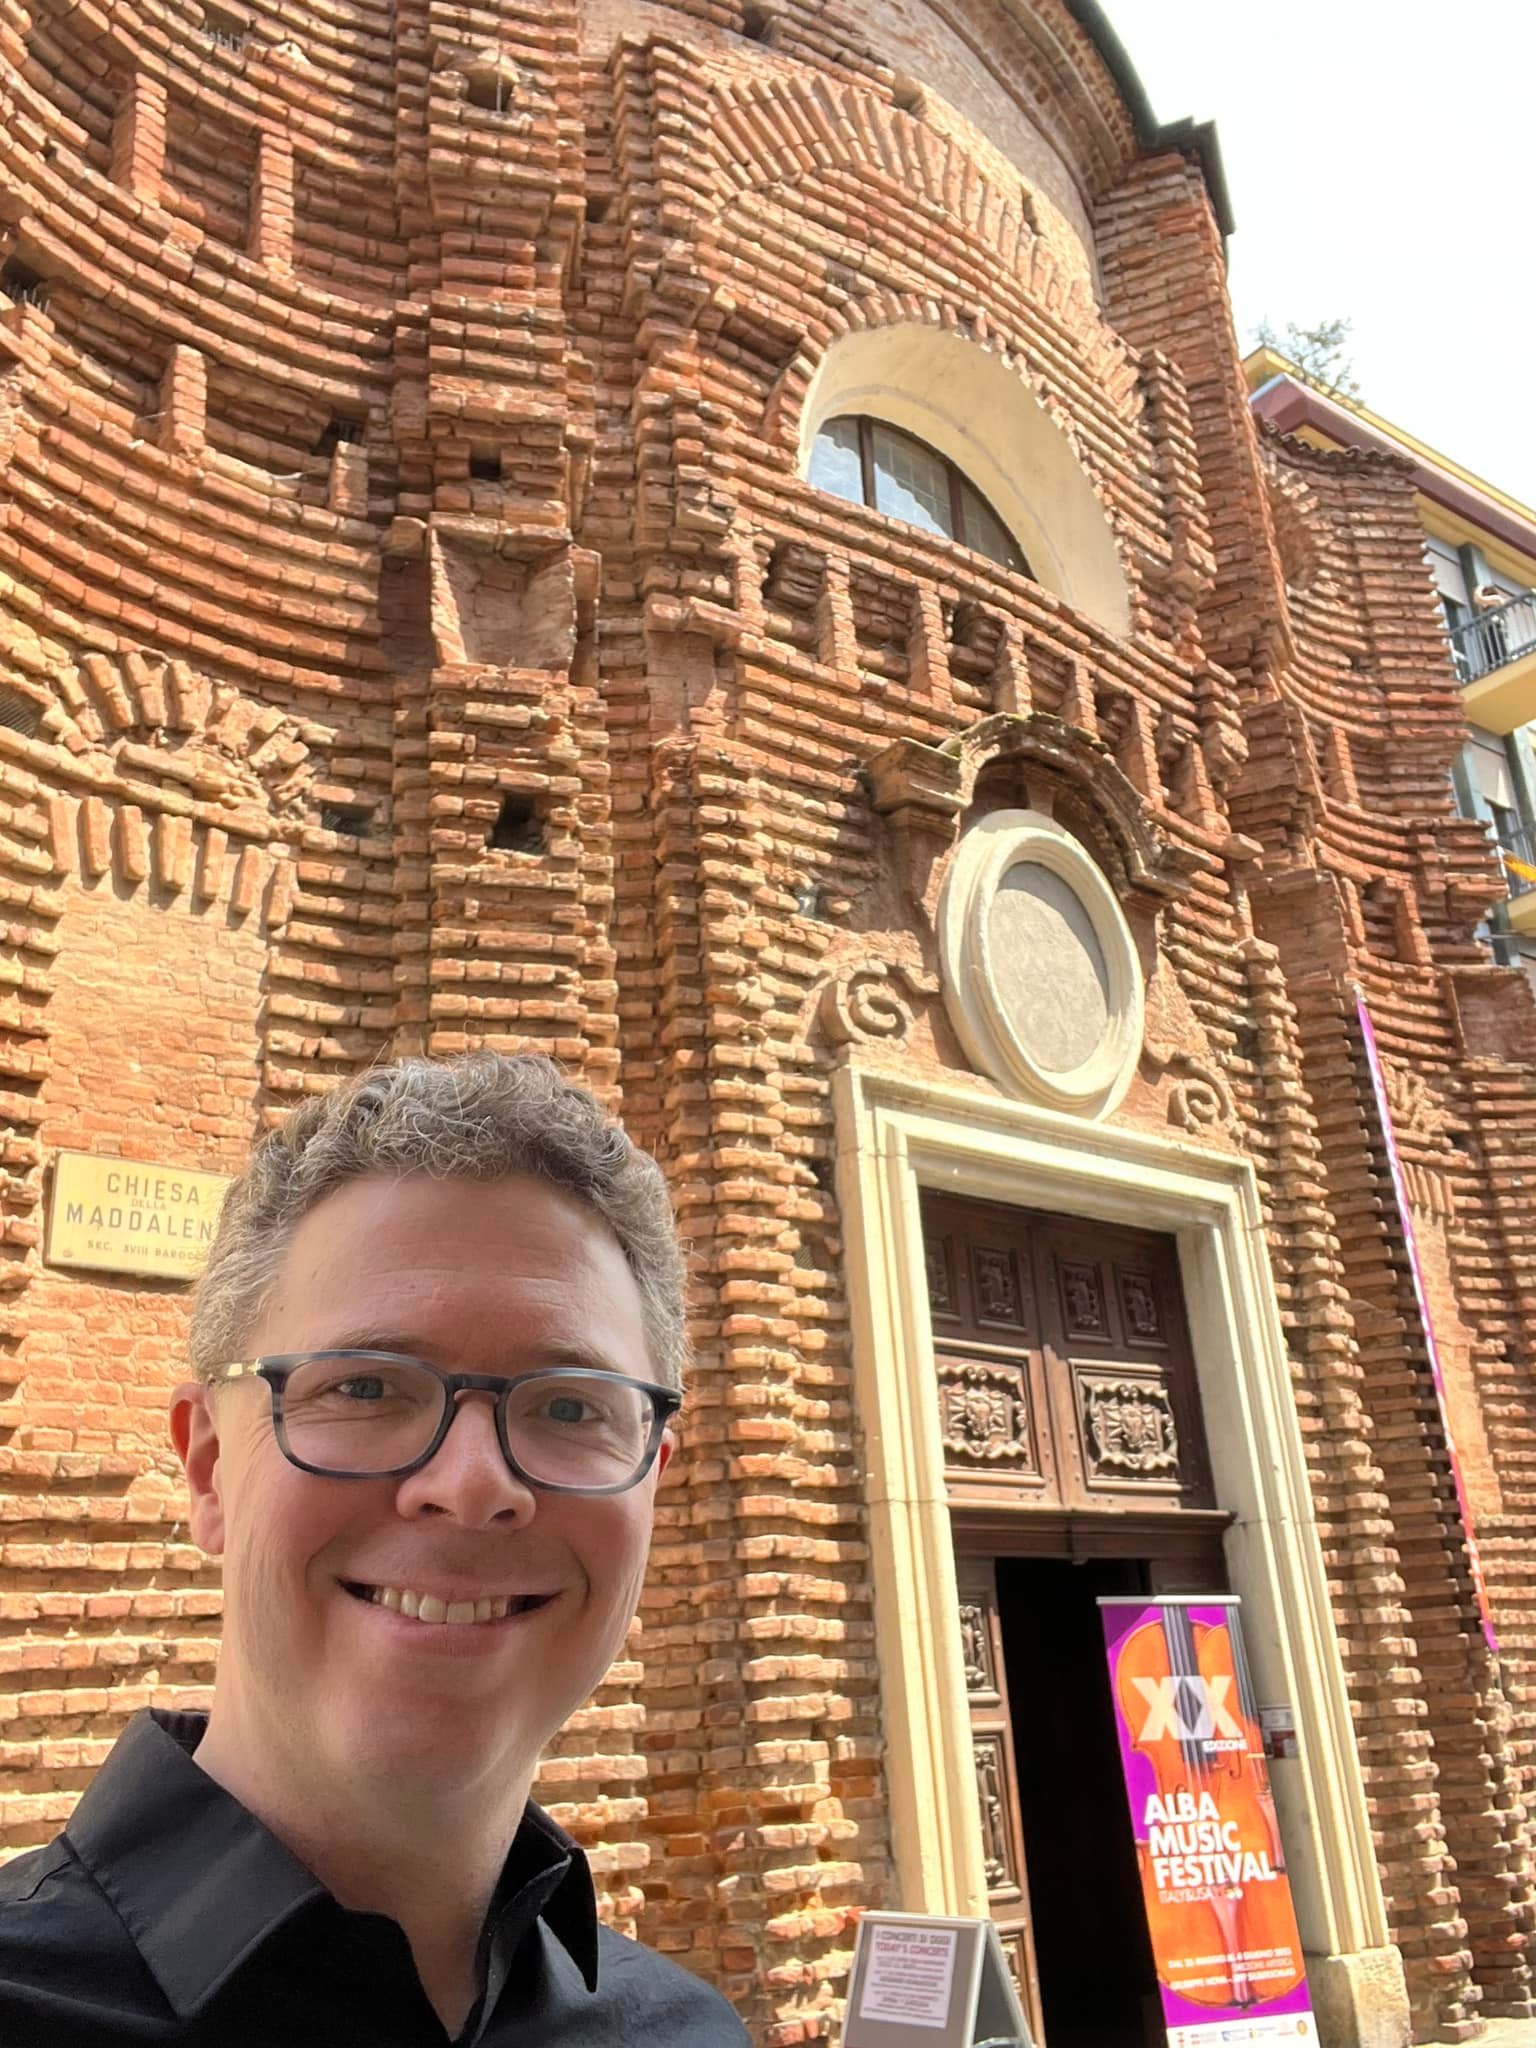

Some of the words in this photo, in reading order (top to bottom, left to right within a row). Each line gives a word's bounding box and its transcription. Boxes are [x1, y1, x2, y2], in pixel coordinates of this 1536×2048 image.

[106, 1172, 200, 1205] CHIESA
[131, 1198, 167, 1211] DELLA
[66, 1202, 214, 1241] MADDALEN
[1131, 1675, 1245, 1742] XX
[1144, 1791, 1220, 1826] ALBA
[1149, 1821, 1241, 1857] MUSIC
[1153, 1851, 1277, 1890] FESTIVAL
